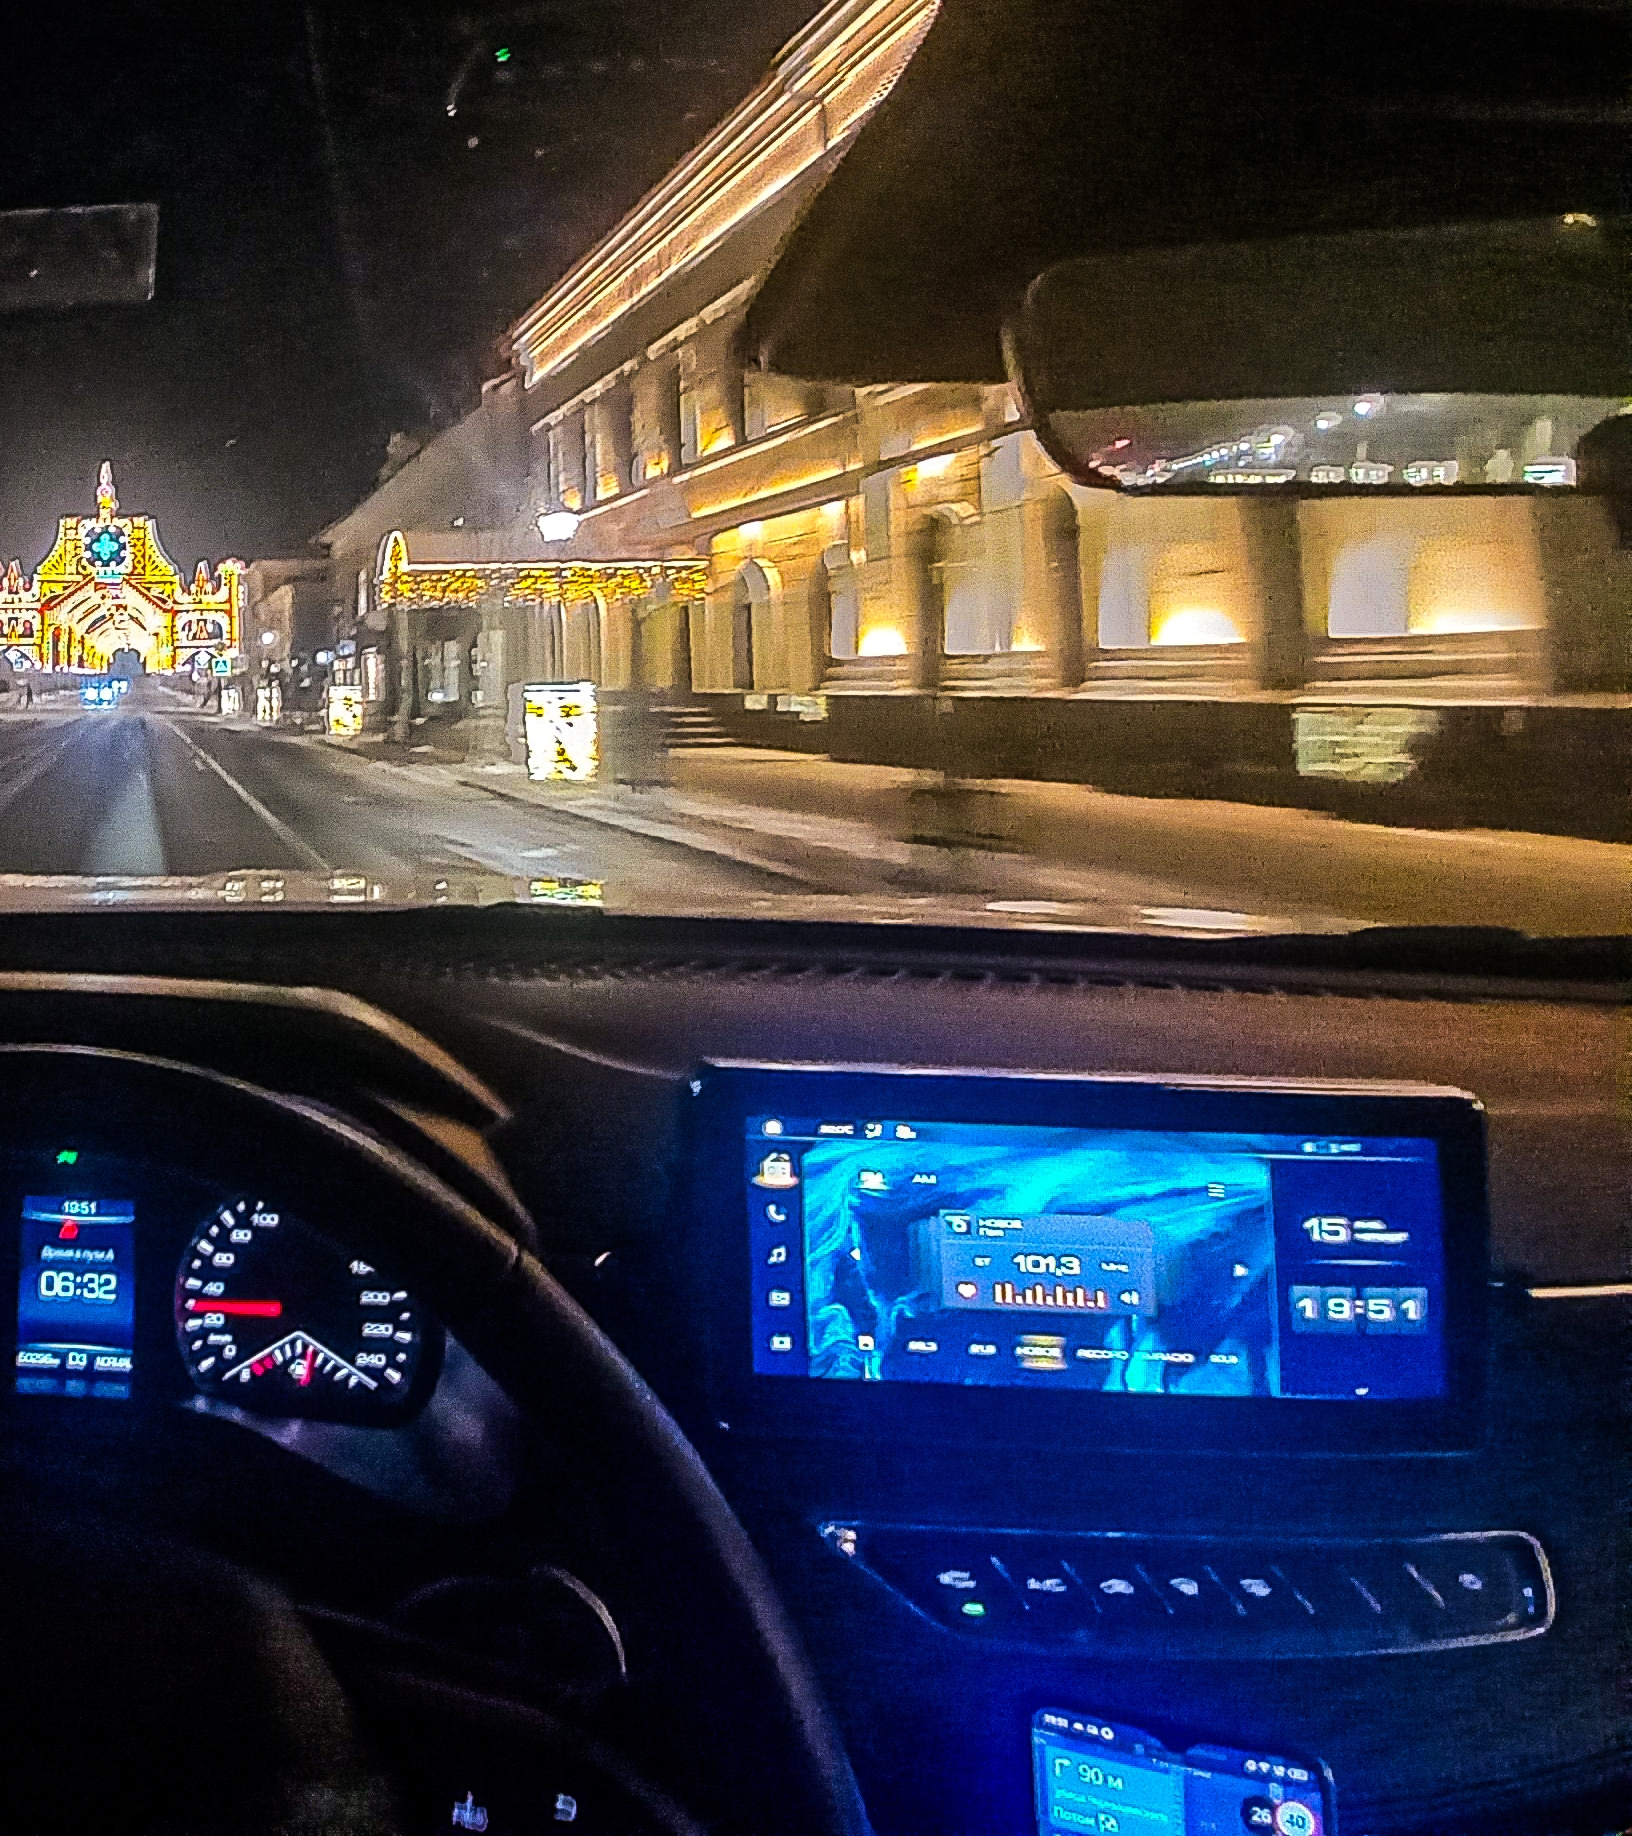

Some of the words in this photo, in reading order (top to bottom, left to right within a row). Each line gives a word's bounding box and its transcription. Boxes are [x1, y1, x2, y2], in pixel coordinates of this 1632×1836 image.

[250, 1213, 280, 1227] 100
[1302, 1216, 1351, 1244] 15
[212, 1252, 235, 1267] 60
[1012, 1254, 1081, 1276] 101,3
[40, 1270, 117, 1301] 06:32
[202, 1281, 225, 1296] 40
[359, 1290, 391, 1305] 200
[1296, 1297, 1421, 1321] 19:51
[203, 1313, 225, 1328] 20
[362, 1322, 394, 1337] 220
[222, 1344, 237, 1359] 0
[355, 1352, 386, 1367] 240
[1078, 1763, 1104, 1785] 90
[1251, 1807, 1272, 1825] 26
